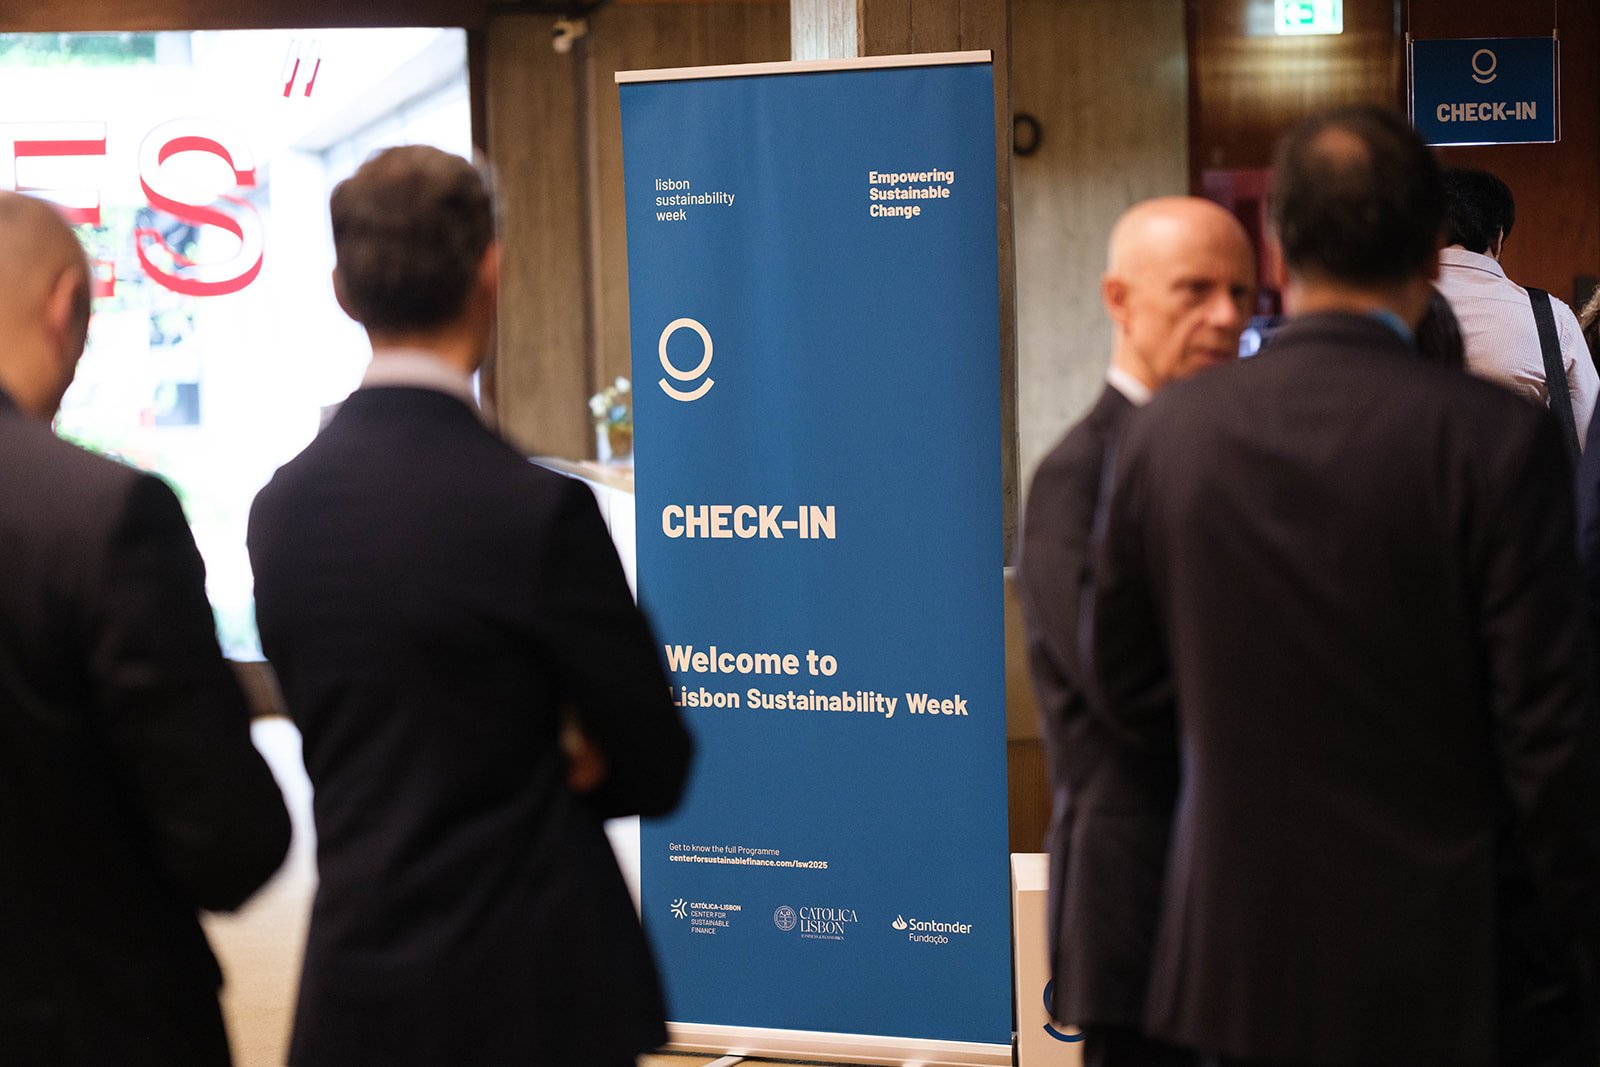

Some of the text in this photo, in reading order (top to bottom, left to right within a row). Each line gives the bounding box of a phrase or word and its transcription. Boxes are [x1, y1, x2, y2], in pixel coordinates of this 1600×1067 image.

[1436, 102, 1537, 122] CHECK-IN
[655, 178, 690, 191] lisbon
[869, 168, 954, 187] Empowering
[655, 192, 735, 207] sustainability
[869, 185, 951, 201] Sustainable
[656, 208, 687, 222] week
[869, 203, 921, 220] Change
[662, 504, 836, 539] CHECK-IN
[665, 645, 838, 676] Welcome to
[669, 685, 969, 718] Lisbon Sustainability Week
[669, 843, 780, 857] Get to know the full Programme
[690, 919, 730, 928] SUSTAINABLE
[691, 927, 717, 935] FINANCE
[800, 919, 844, 935] LISBON
[909, 918, 972, 934] Santander
[908, 933, 949, 945] Fundação
